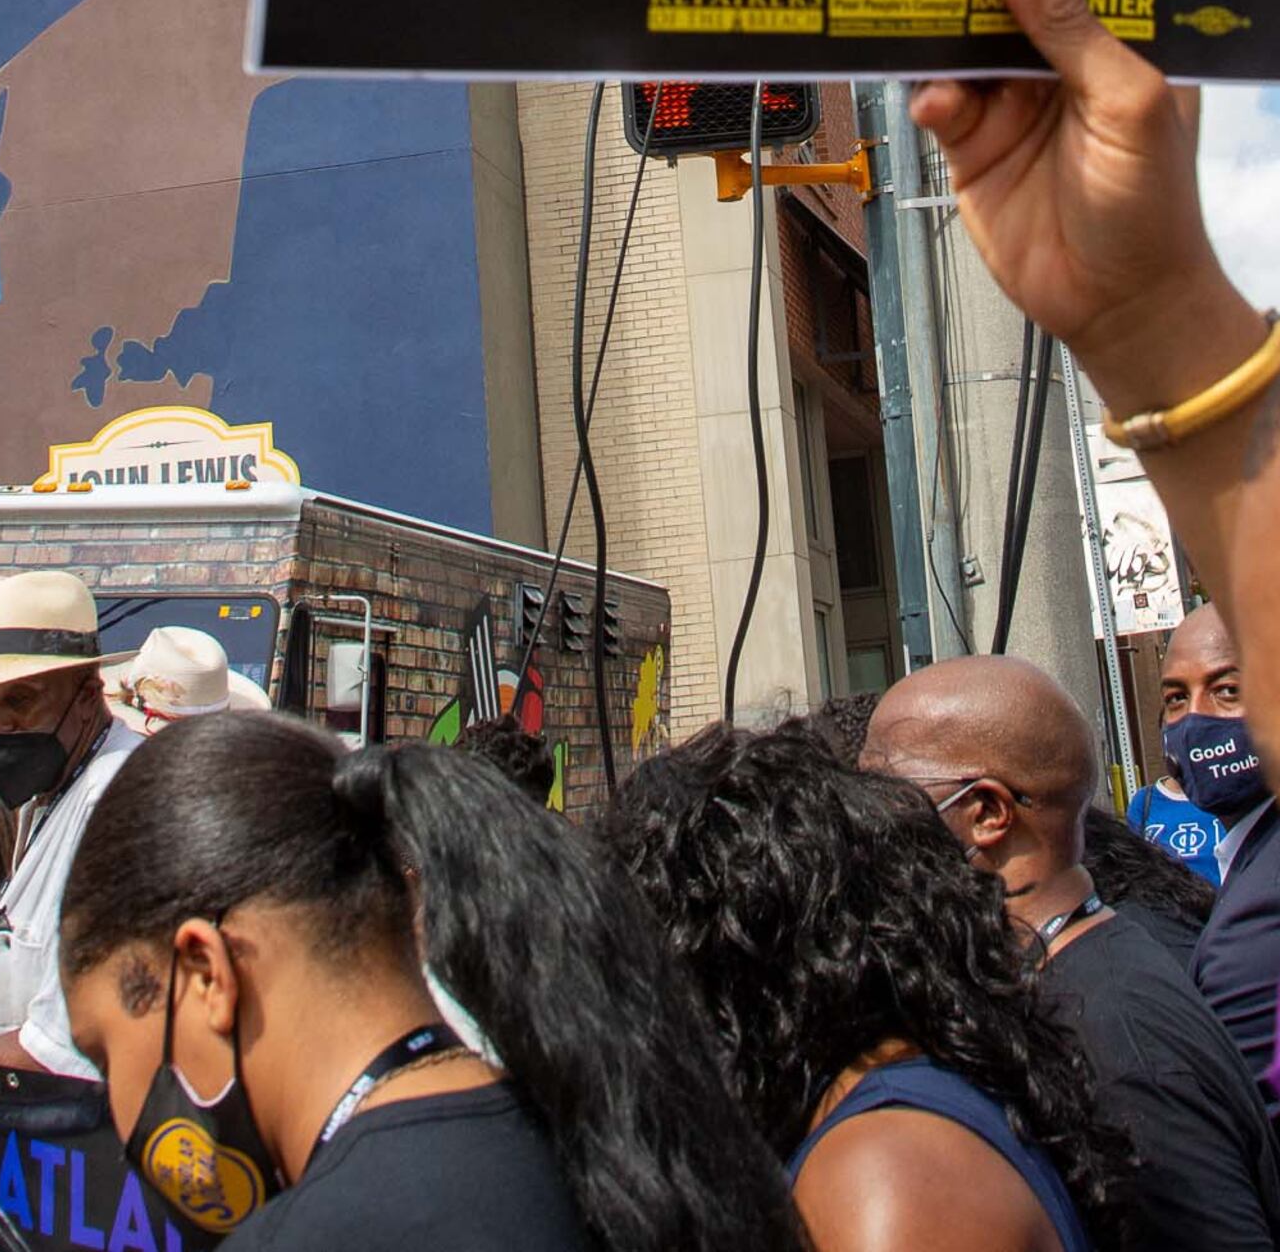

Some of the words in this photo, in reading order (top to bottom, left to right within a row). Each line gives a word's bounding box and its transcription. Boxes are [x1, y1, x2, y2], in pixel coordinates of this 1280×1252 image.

[160, 453, 258, 484] LEWIS
[1190, 738, 1236, 763] Good
[1209, 755, 1260, 779] Troub
